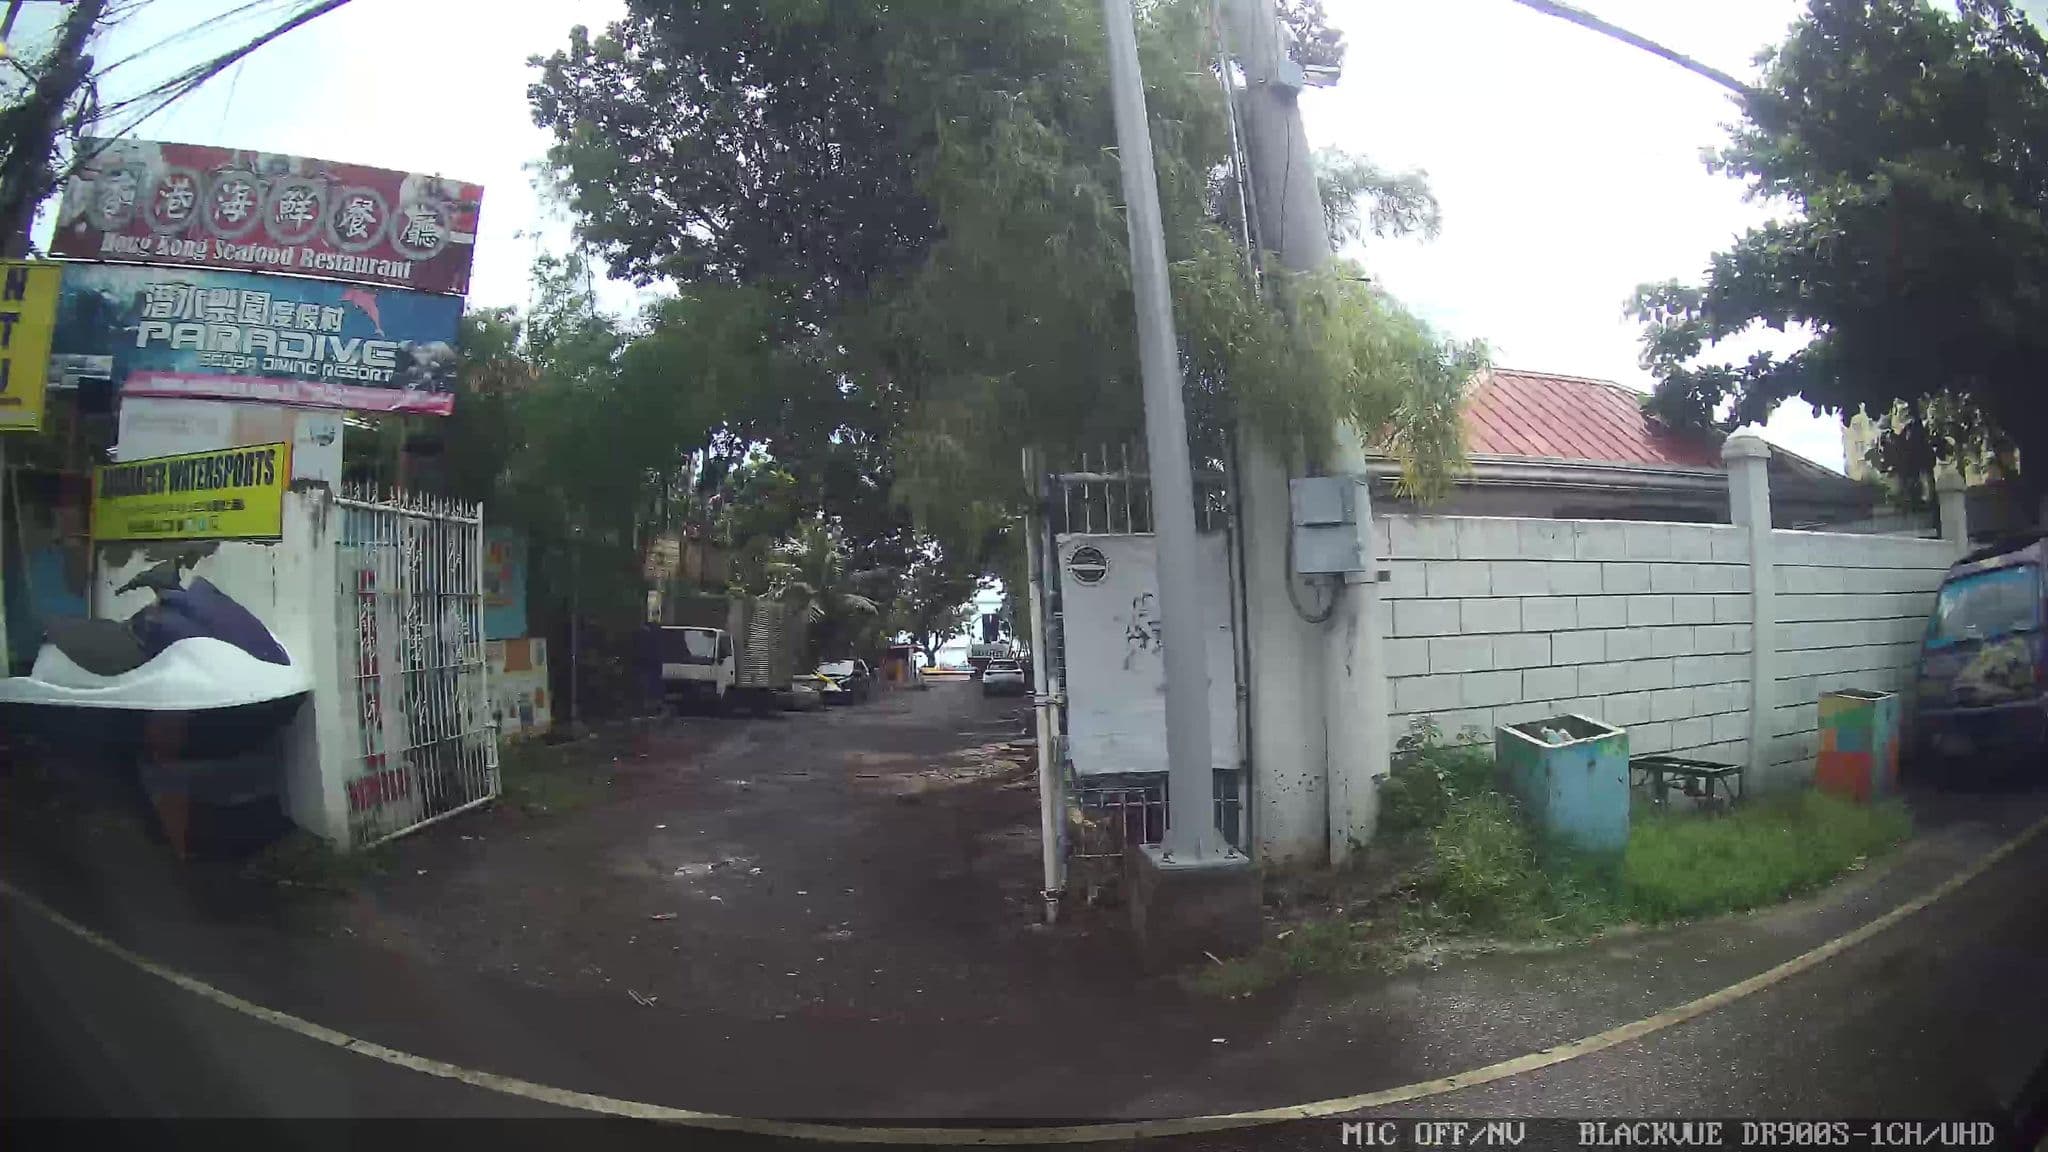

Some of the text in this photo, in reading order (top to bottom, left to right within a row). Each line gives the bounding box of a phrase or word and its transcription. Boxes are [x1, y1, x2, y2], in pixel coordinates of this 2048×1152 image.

[100, 231, 413, 279] Hong Kong Seafood Restaurant
[135, 320, 400, 369] PARADIVE
[321, 363, 395, 382] RESORT
[169, 448, 276, 493] WATERSPORTS
